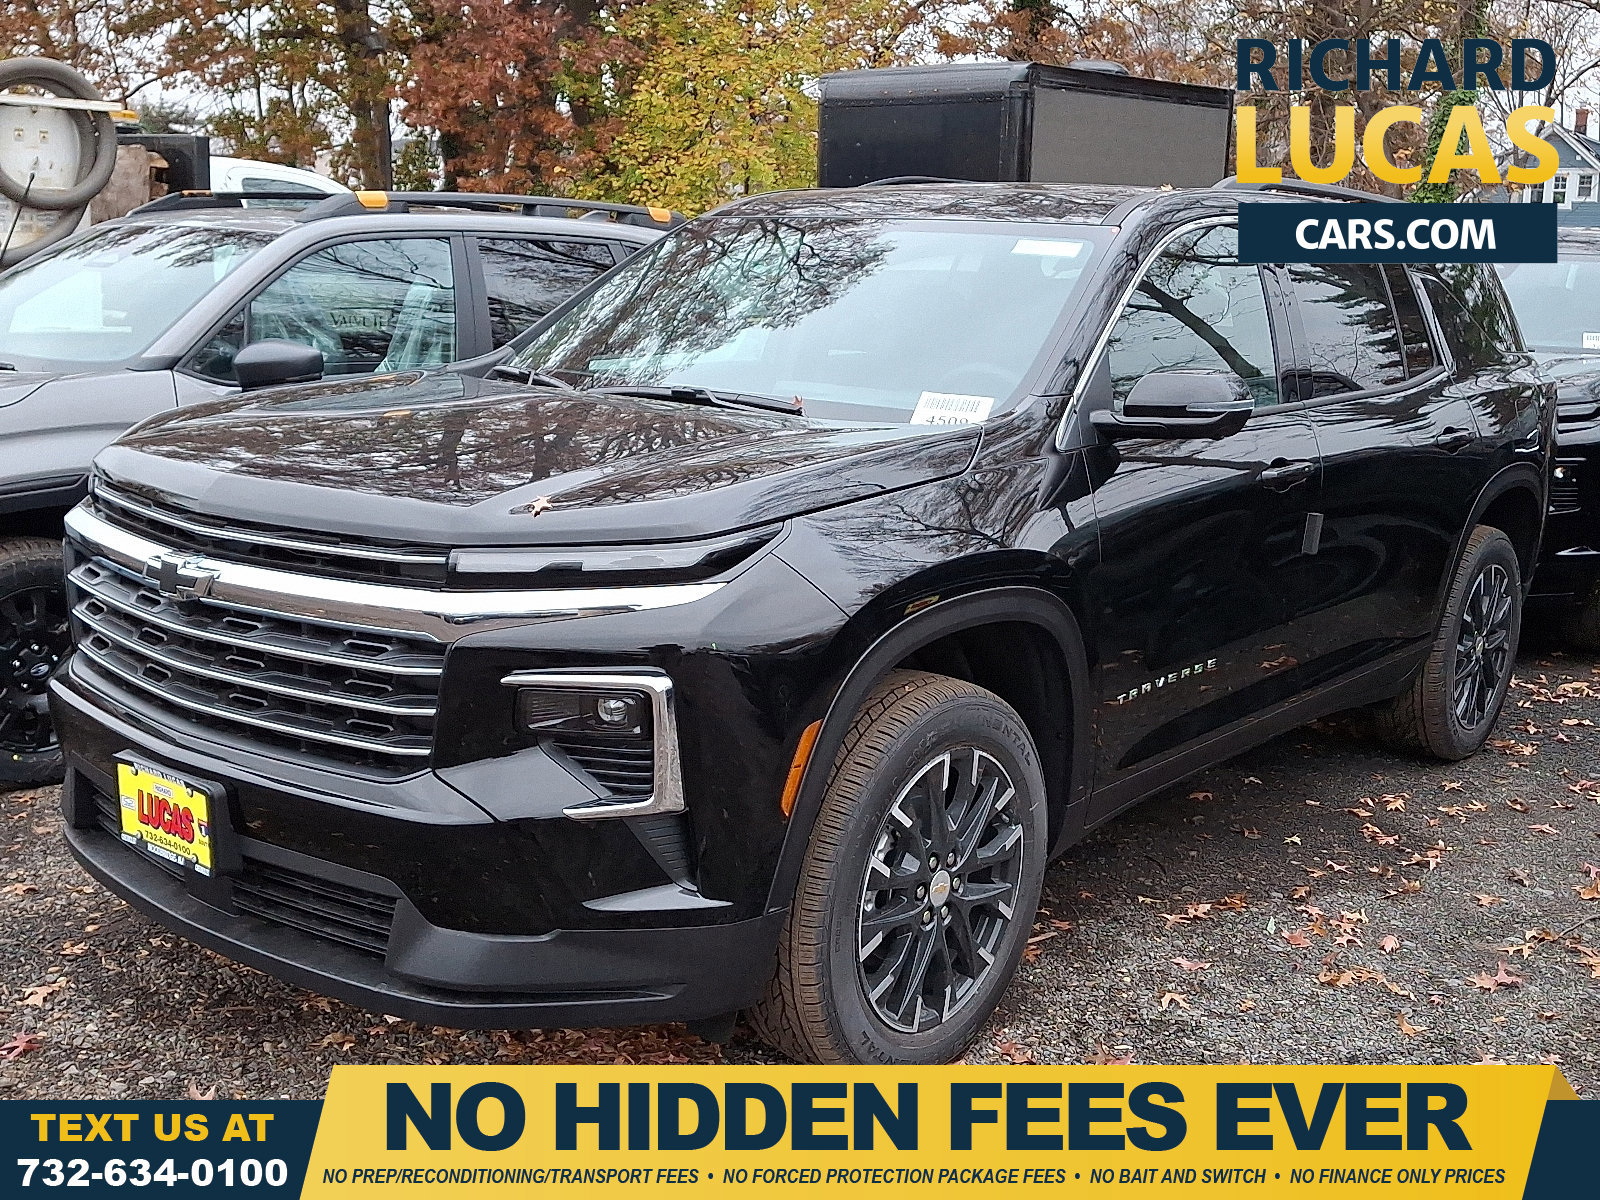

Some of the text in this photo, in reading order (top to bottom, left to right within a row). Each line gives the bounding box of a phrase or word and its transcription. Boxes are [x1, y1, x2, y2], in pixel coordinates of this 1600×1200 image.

[1116, 658, 1218, 705] TRAVERSE
[138, 788, 195, 845] LUCAS
[145, 830, 191, 856] 732-634-0100
